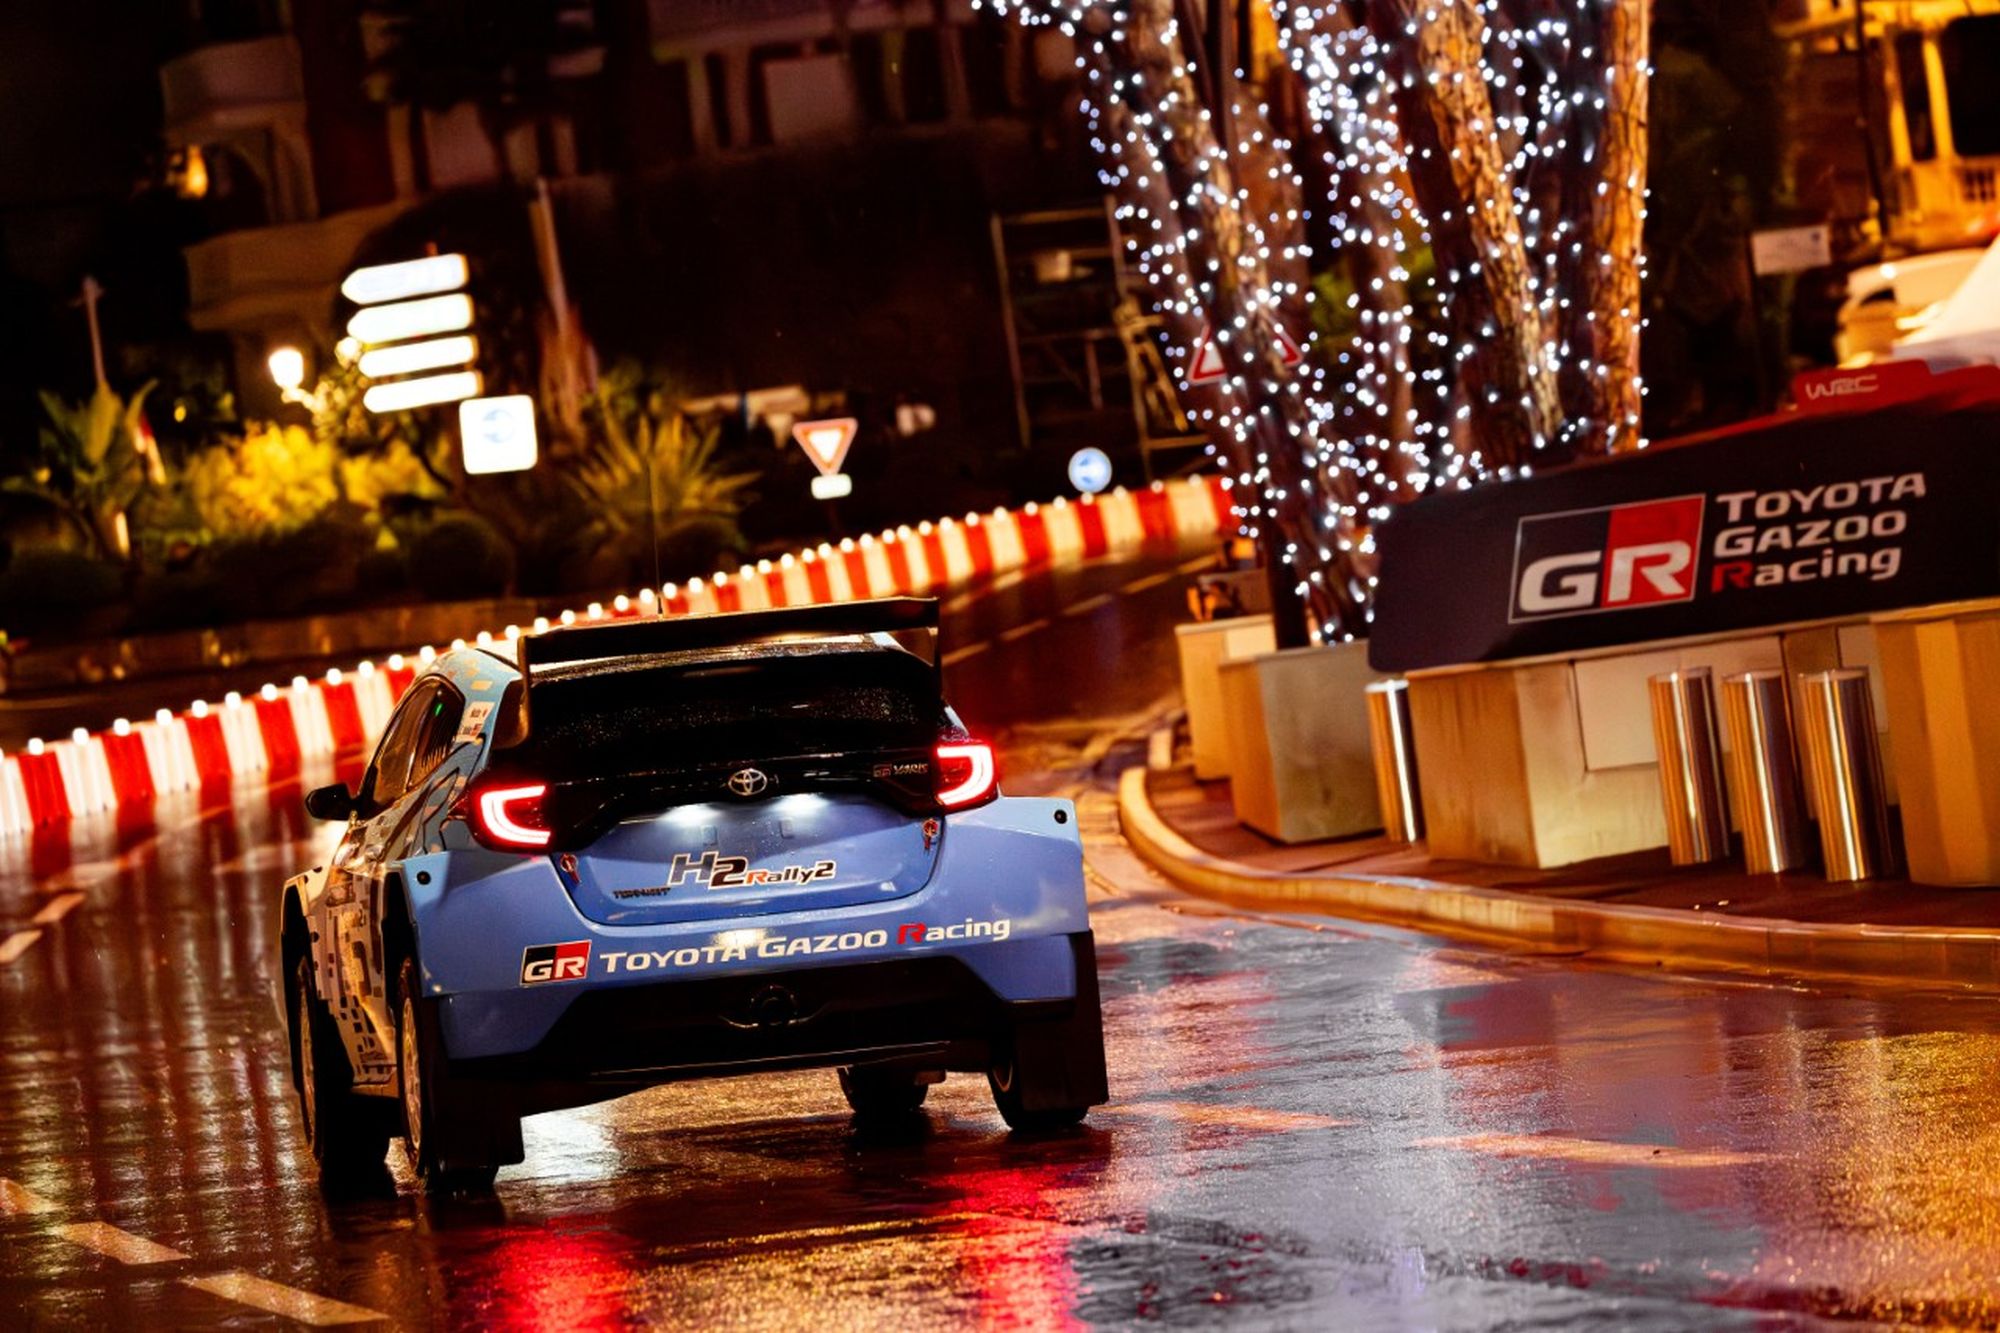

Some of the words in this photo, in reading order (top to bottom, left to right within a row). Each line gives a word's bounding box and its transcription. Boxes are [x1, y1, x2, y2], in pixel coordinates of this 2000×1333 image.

[1805, 374, 1879, 399] WRC
[1716, 472, 1926, 523] TOYOTA
[1714, 510, 1907, 557] GAZOO
[1519, 540, 1692, 613] GR
[1711, 547, 1902, 593] Racing
[523, 956, 586, 982] GR
[600, 945, 747, 974] TOYOTA
[757, 929, 888, 958] GAZOO
[897, 918, 1011, 944] Racing
